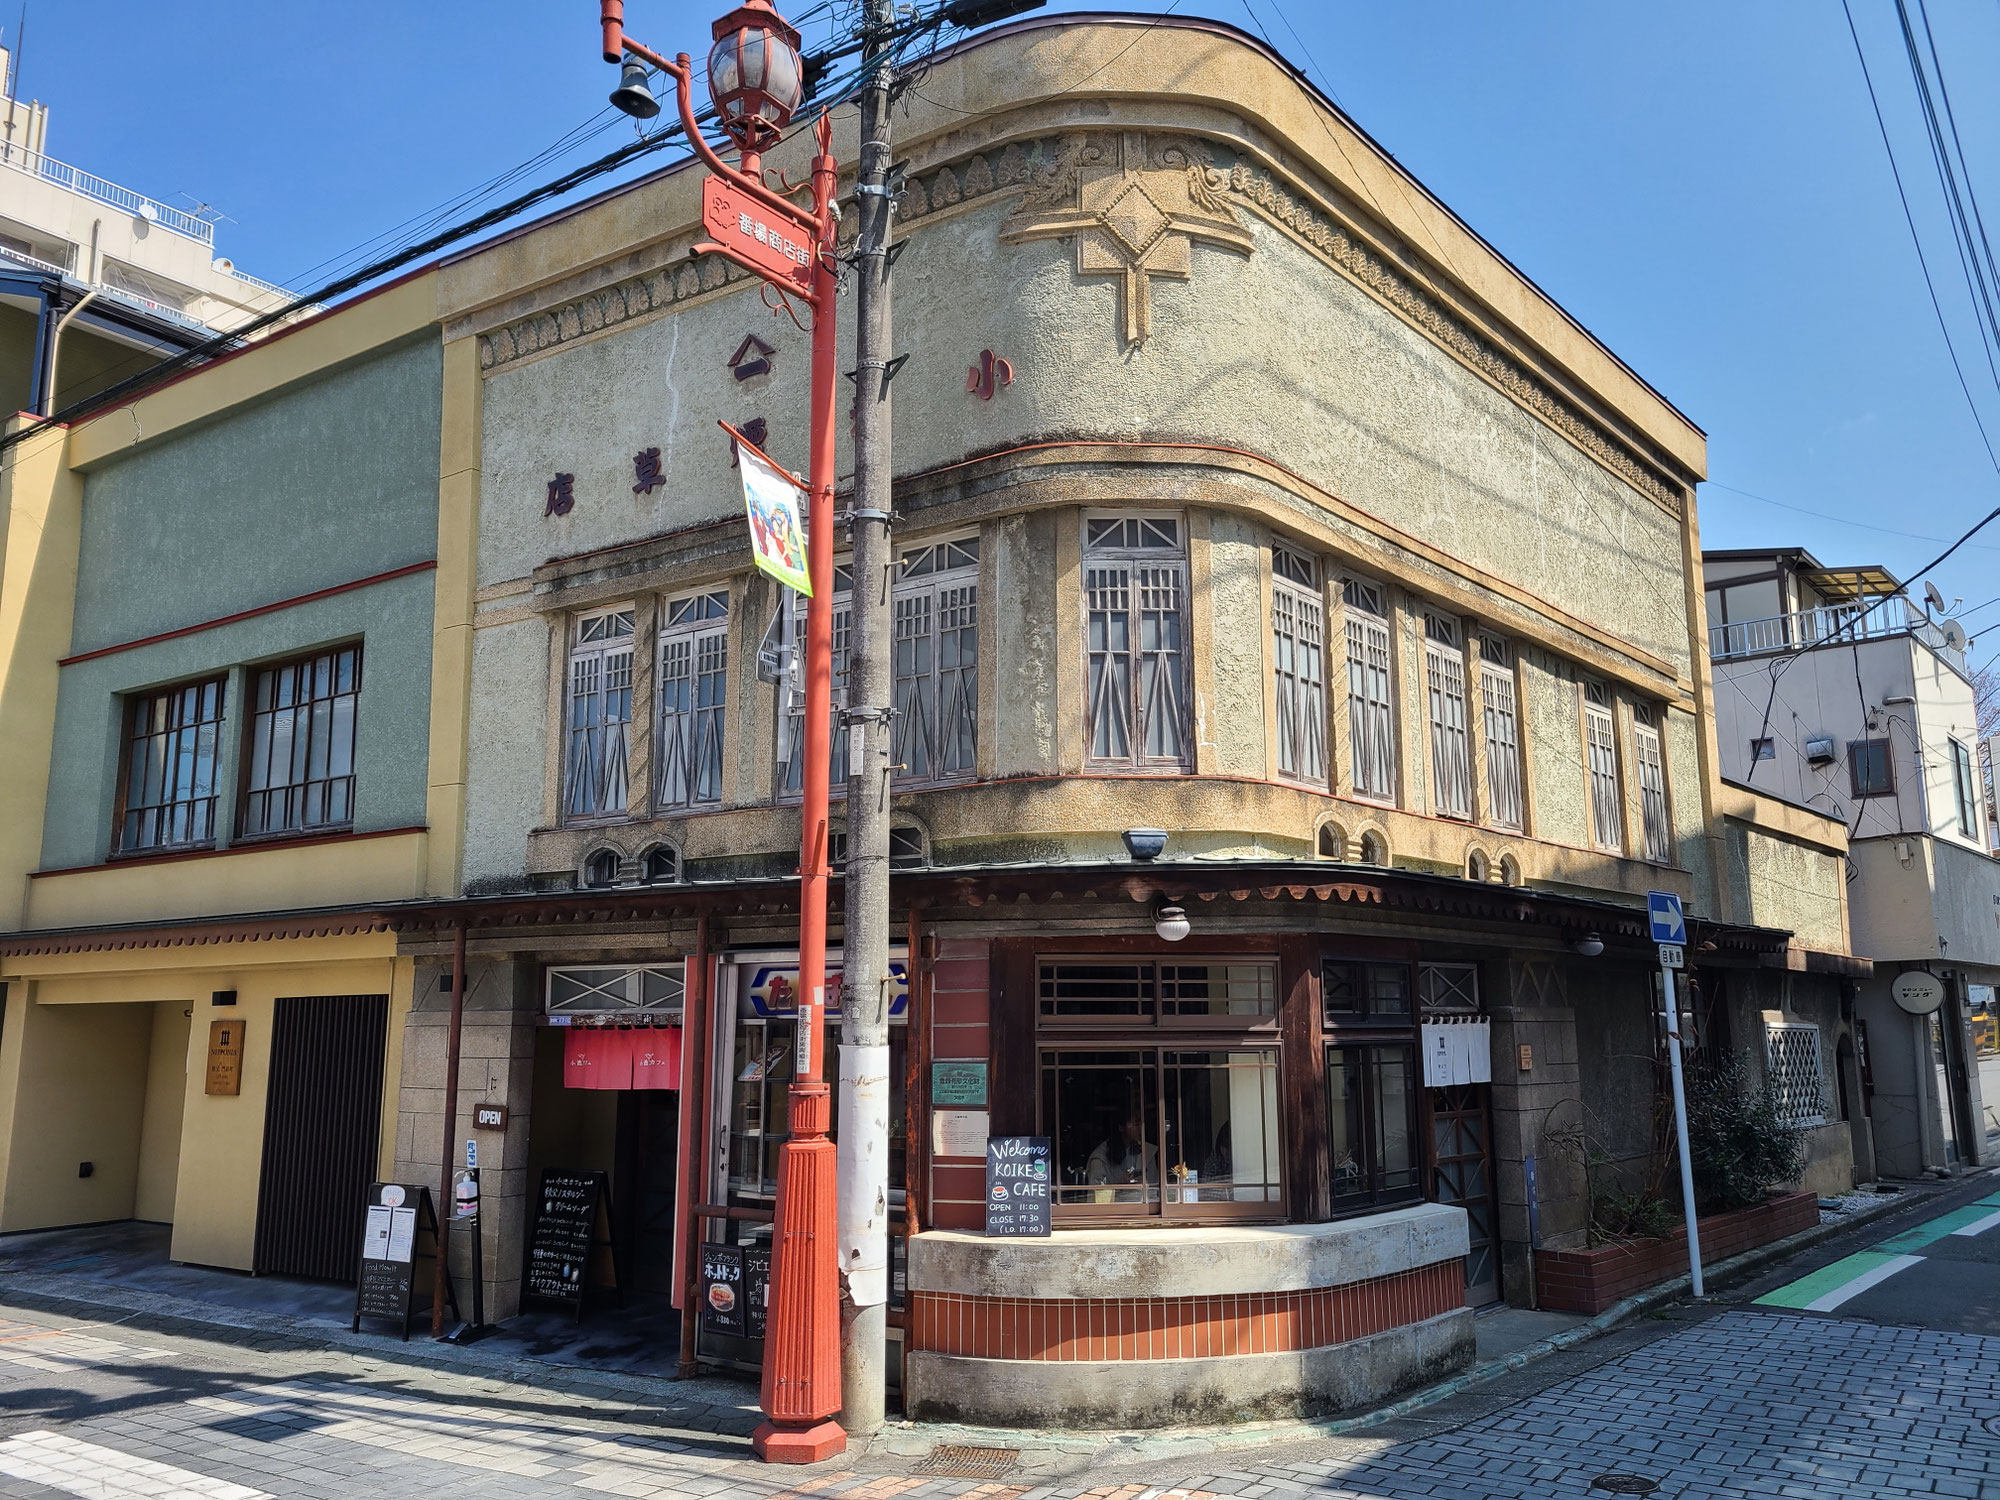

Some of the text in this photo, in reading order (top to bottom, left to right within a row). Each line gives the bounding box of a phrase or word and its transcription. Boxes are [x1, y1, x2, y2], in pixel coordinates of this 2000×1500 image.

[738, 211, 810, 268] 番場商店街
[1662, 950, 1682, 963] 自動車
[479, 1109, 502, 1126] OPEN
[991, 1139, 1049, 1160] Welcome
[995, 1162, 1034, 1178] KOIKE
[1013, 1182, 1046, 1197] CAFE
[989, 1203, 1039, 1212] OPEN 11:00
[989, 1214, 1039, 1224] CLOSE 17:30
